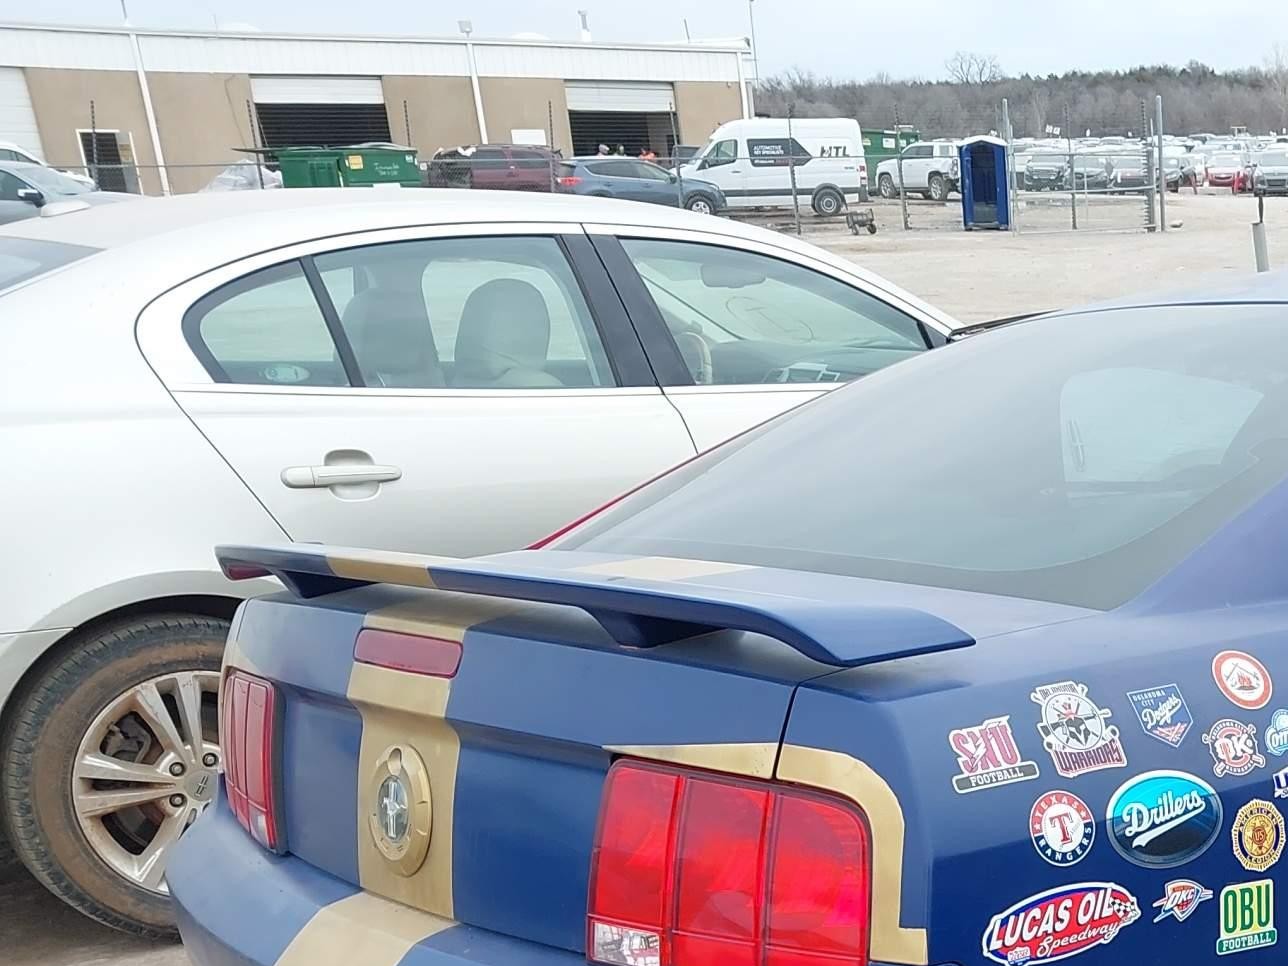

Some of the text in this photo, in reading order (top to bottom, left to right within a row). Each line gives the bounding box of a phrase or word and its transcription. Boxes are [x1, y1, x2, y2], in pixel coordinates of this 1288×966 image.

[1132, 689, 1166, 702] OKLAHOMA
[1141, 699, 1154, 707] CITY
[1141, 693, 1182, 730] Dodgers
[1055, 737, 1123, 772] WARRIORS
[968, 767, 1024, 787] FOOTBALL
[1035, 795, 1079, 820] TEXAS
[1122, 790, 1206, 840] Drillers
[1240, 806, 1278, 832] AMERICAN
[1038, 826, 1093, 862] RANGERS
[1049, 812, 1075, 846] T
[989, 887, 1113, 951] LUCAS OIL
[1223, 884, 1272, 934] OBU
[1036, 922, 1118, 958] Speedway
[1222, 933, 1272, 951] FOOTBALL
